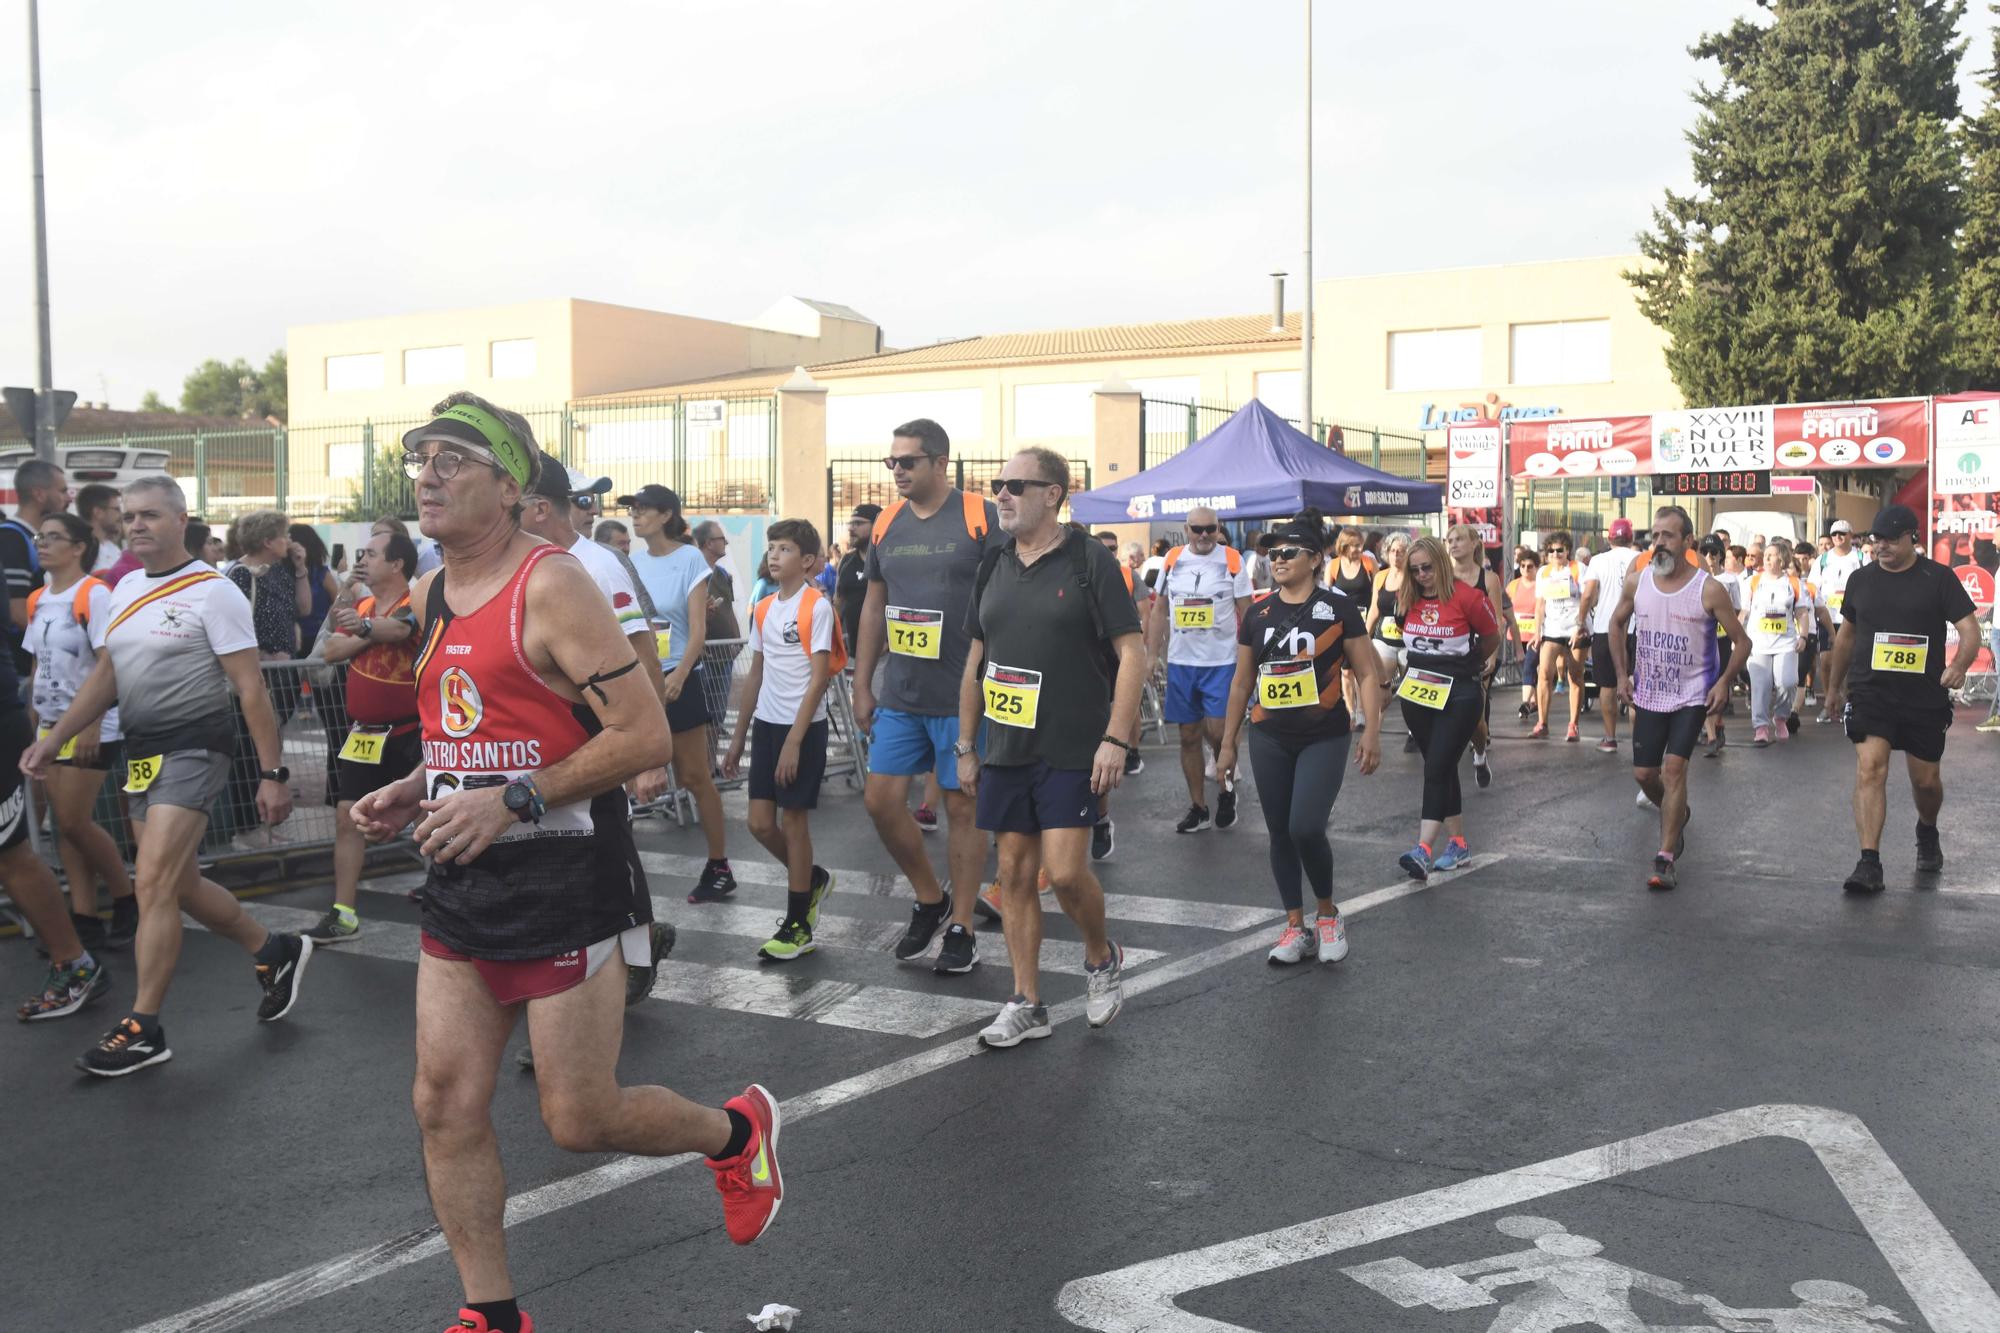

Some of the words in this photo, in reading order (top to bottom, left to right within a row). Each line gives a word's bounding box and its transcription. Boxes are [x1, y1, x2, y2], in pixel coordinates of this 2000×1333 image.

[1690, 411, 1763, 427] XXVIII
[1961, 409, 1988, 426] AC
[1690, 426, 1763, 441] NON
[1802, 415, 1879, 439] FAMU
[1547, 428, 1613, 451] FAMU
[1691, 440, 1764, 455] DUER
[1691, 454, 1764, 468] MAS
[1181, 611, 1206, 622] 775
[1428, 625, 1454, 636] SANTOS
[1764, 622, 1782, 630] 710
[895, 629, 928, 648] 713
[1653, 631, 1689, 652] CROSS
[1660, 650, 1694, 666] LIBRILLA
[1883, 650, 1916, 665] 788
[1267, 681, 1303, 700] 821
[1409, 685, 1439, 702] 728
[989, 689, 1023, 715] 725
[353, 740, 375, 755] 717
[461, 739, 542, 769] SANTOS
